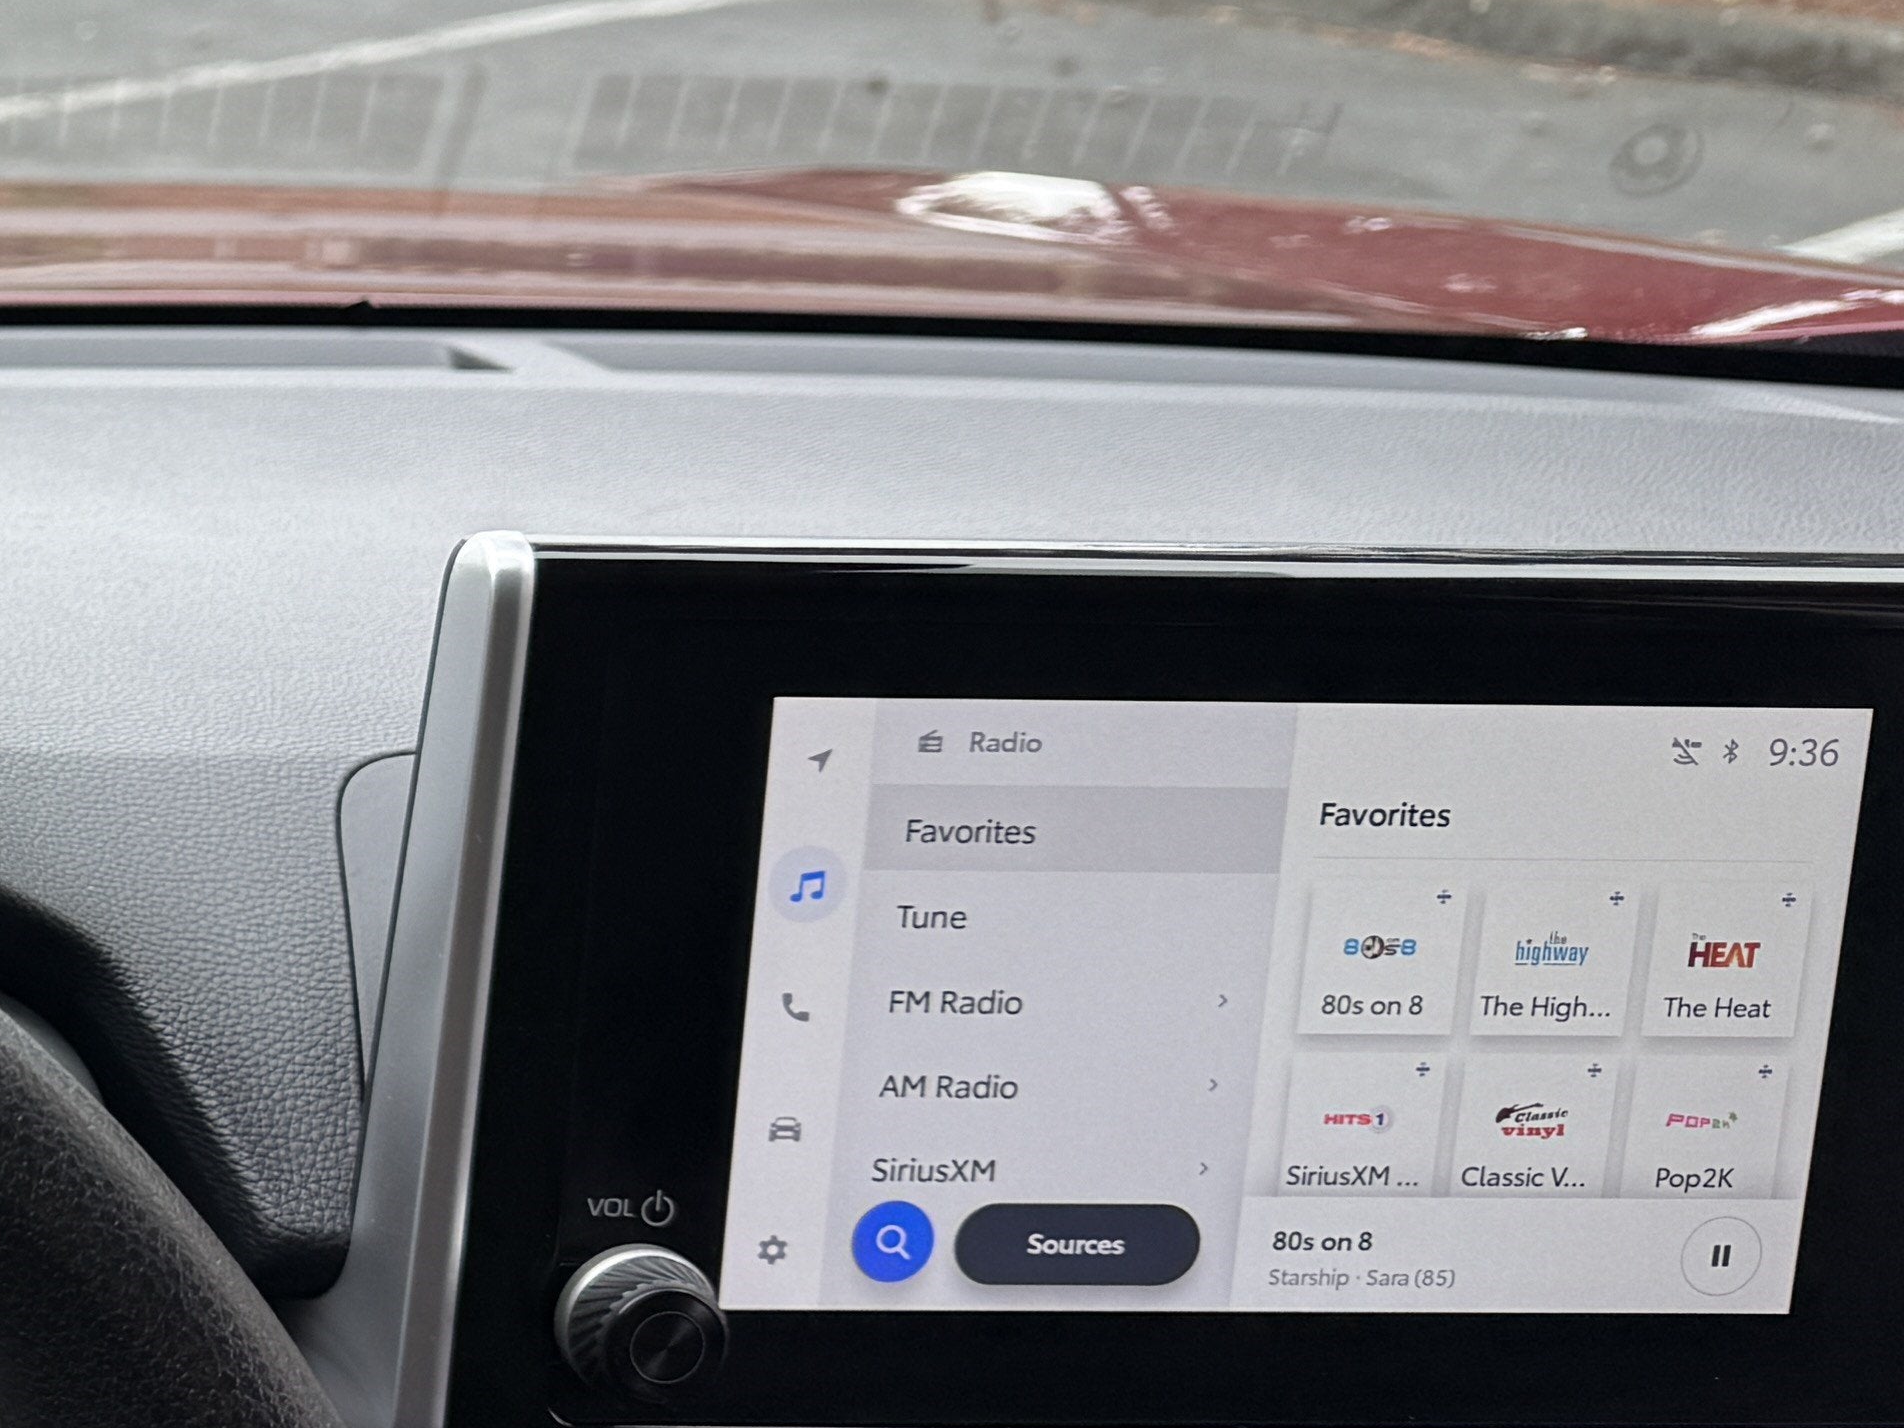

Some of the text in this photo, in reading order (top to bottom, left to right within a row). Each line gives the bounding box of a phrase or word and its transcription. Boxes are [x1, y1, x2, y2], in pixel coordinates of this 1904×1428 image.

[968, 730, 1044, 753] Radio
[1769, 737, 1841, 768] 9:36
[1319, 801, 1452, 828] Favorites
[904, 818, 1037, 844] Favorites
[896, 904, 968, 929] Tune
[1548, 930, 1568, 946] the
[1514, 937, 1590, 966] highway
[1687, 941, 1762, 969] HEAT
[888, 988, 1024, 1015] FM Radio
[1321, 993, 1424, 1016] 80s on 8
[1480, 995, 1524, 1016] The
[1663, 996, 1772, 1018] The Heat
[878, 1073, 1020, 1100] AM Radio
[1323, 1112, 1373, 1126] HITS
[1514, 1107, 1569, 1123] Classic
[1500, 1123, 1566, 1140] vinyl
[870, 1157, 997, 1184] SiriusXM
[1285, 1164, 1391, 1187] SiriusXM
[1460, 1165, 1544, 1188] Classic
[1654, 1167, 1735, 1194] Pop2K
[587, 1197, 635, 1218] VOL
[1026, 1232, 1126, 1256] Sources
[1272, 1230, 1373, 1252] 80s on 8
[1268, 1268, 1457, 1290] Starship Sara (85)
